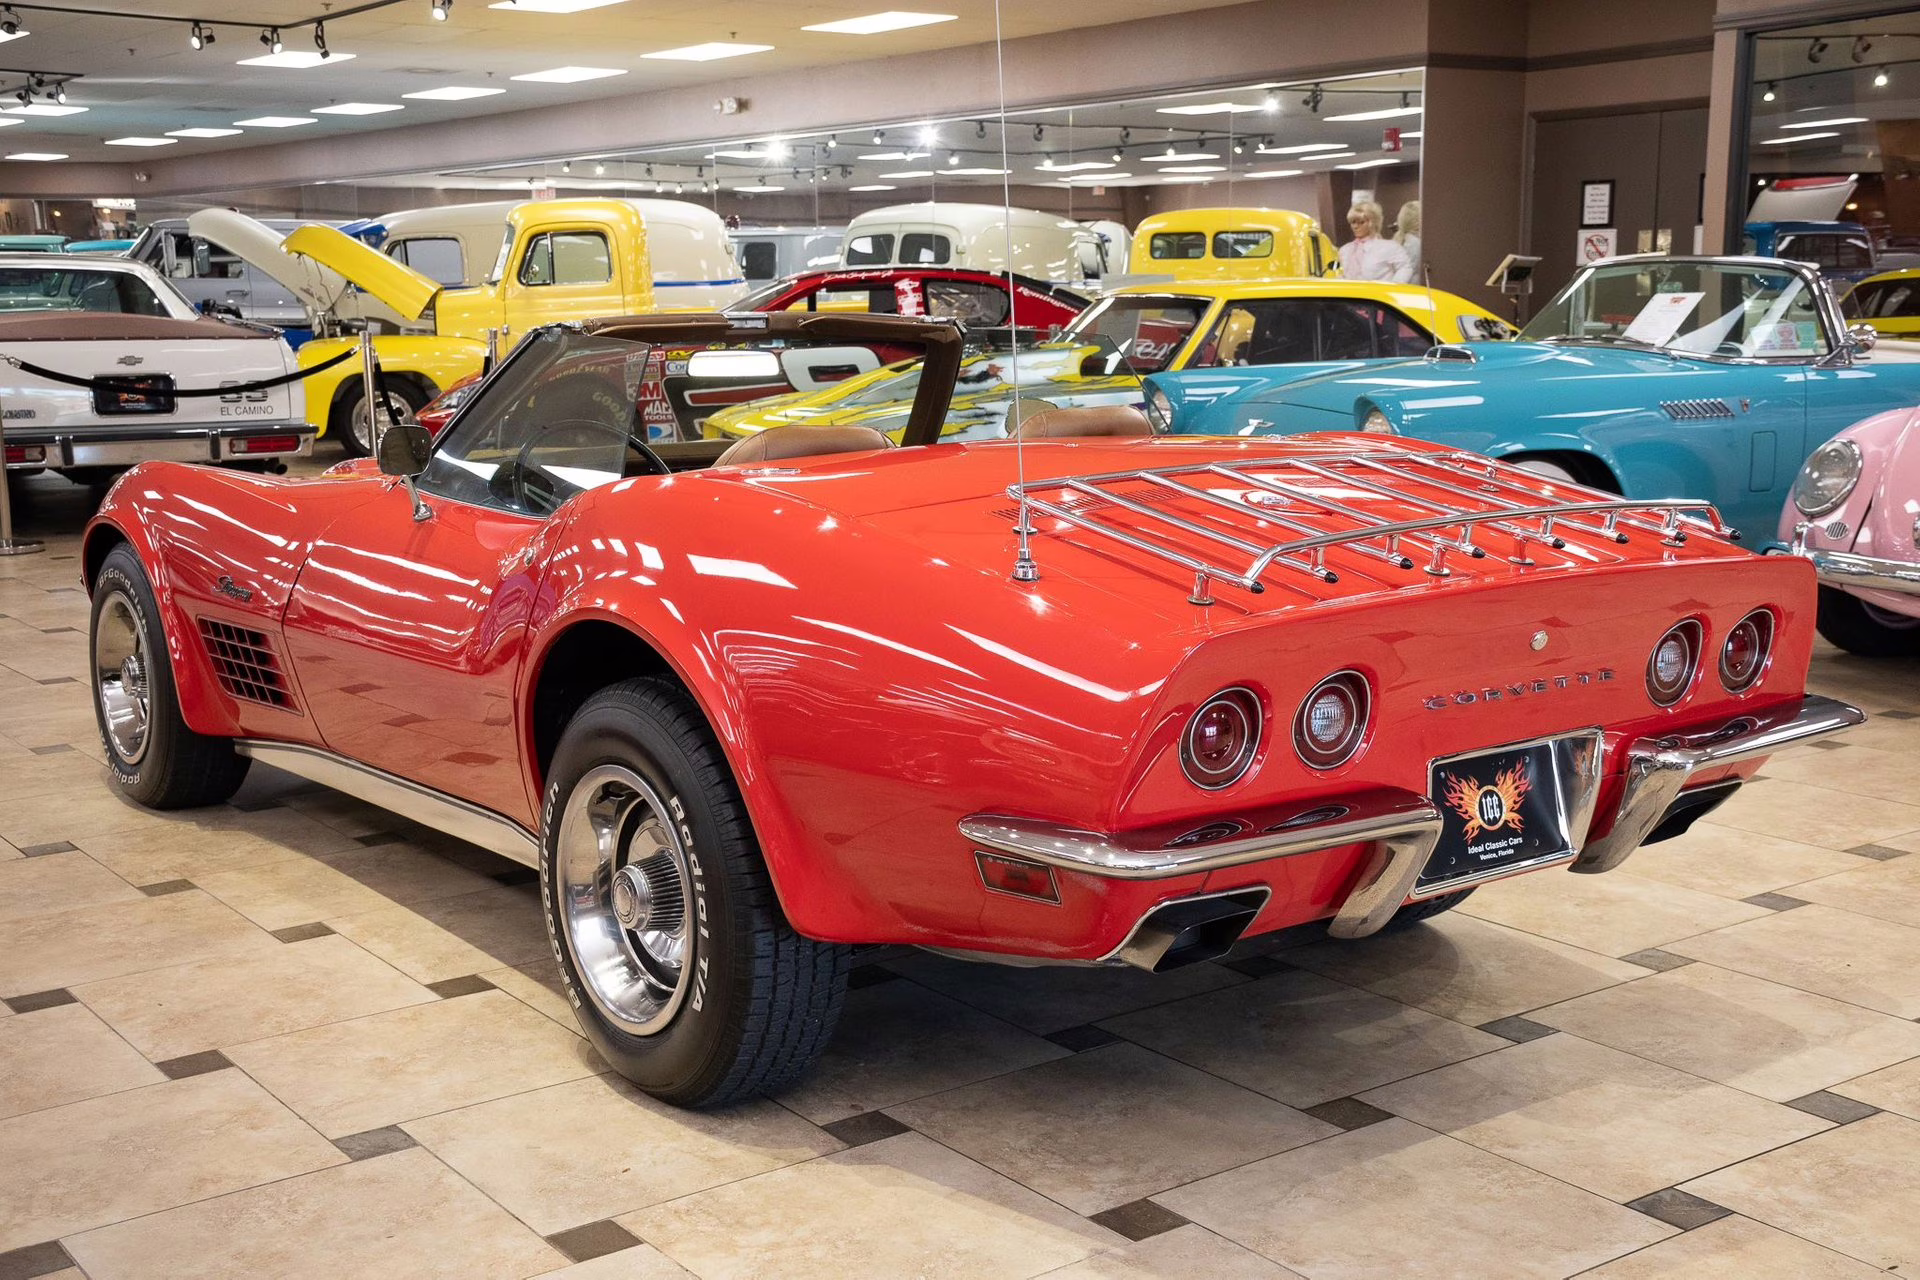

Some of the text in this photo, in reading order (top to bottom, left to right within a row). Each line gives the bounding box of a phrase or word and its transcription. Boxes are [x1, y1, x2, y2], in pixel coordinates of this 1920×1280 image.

[220, 405, 274, 416] EL CAMINO
[644, 401, 672, 415] MAC
[98, 567, 148, 634] BFGoodrich
[1423, 668, 1616, 711] CORVETTE
[1467, 836, 1523, 855] Ideal Classic Cars
[1480, 848, 1514, 861] Venice, Florida
[542, 781, 582, 1010] BFGoodrich
[669, 794, 711, 1013] Radial T/A
